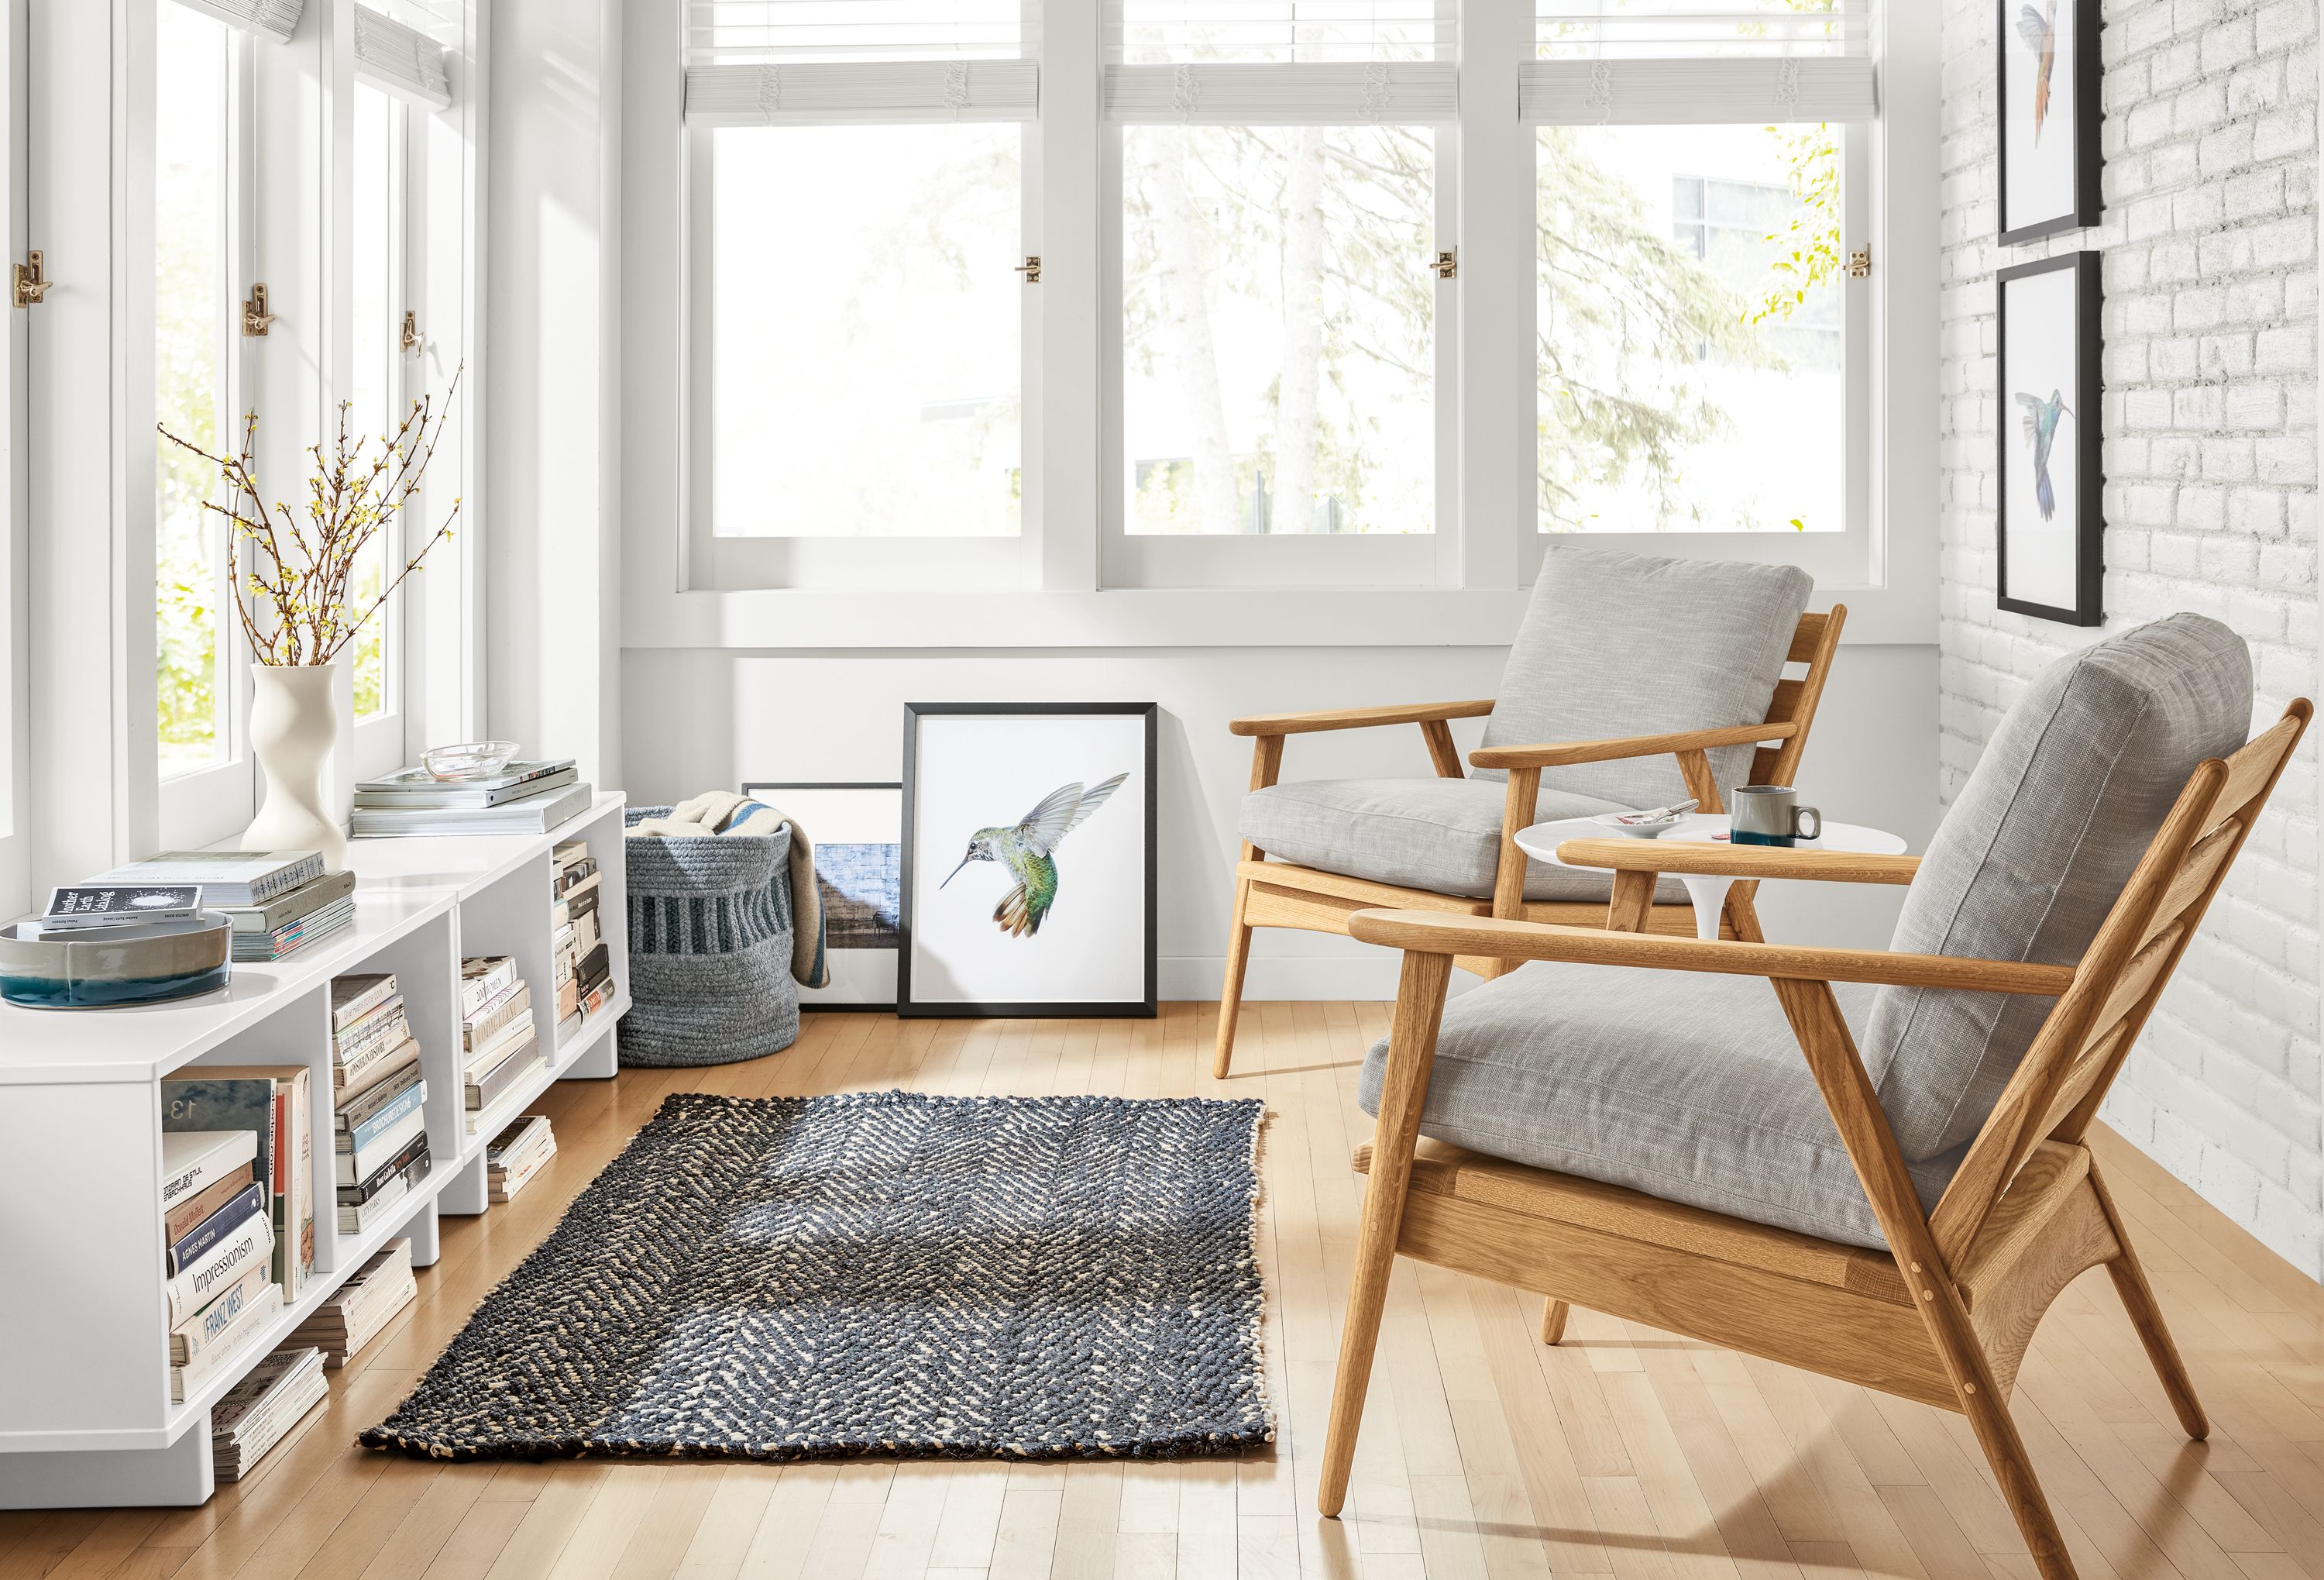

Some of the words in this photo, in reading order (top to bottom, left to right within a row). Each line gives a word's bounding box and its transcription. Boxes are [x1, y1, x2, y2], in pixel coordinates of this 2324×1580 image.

[57, 891, 78, 914] Another
[76, 895, 94, 911] Earth
[91, 890, 115, 912] Catalog
[476, 1000, 516, 1046] MODIGLIANI
[182, 1173, 189, 1182] DE
[174, 1216, 188, 1236] Donald
[262, 1217, 271, 1244] TASCHEN
[182, 1243, 198, 1262] AGNES
[198, 1229, 215, 1250] MARTIN
[192, 1237, 254, 1294] Impressionism
[205, 1301, 227, 1341] FRANZ
[226, 1283, 244, 1317] WEST
